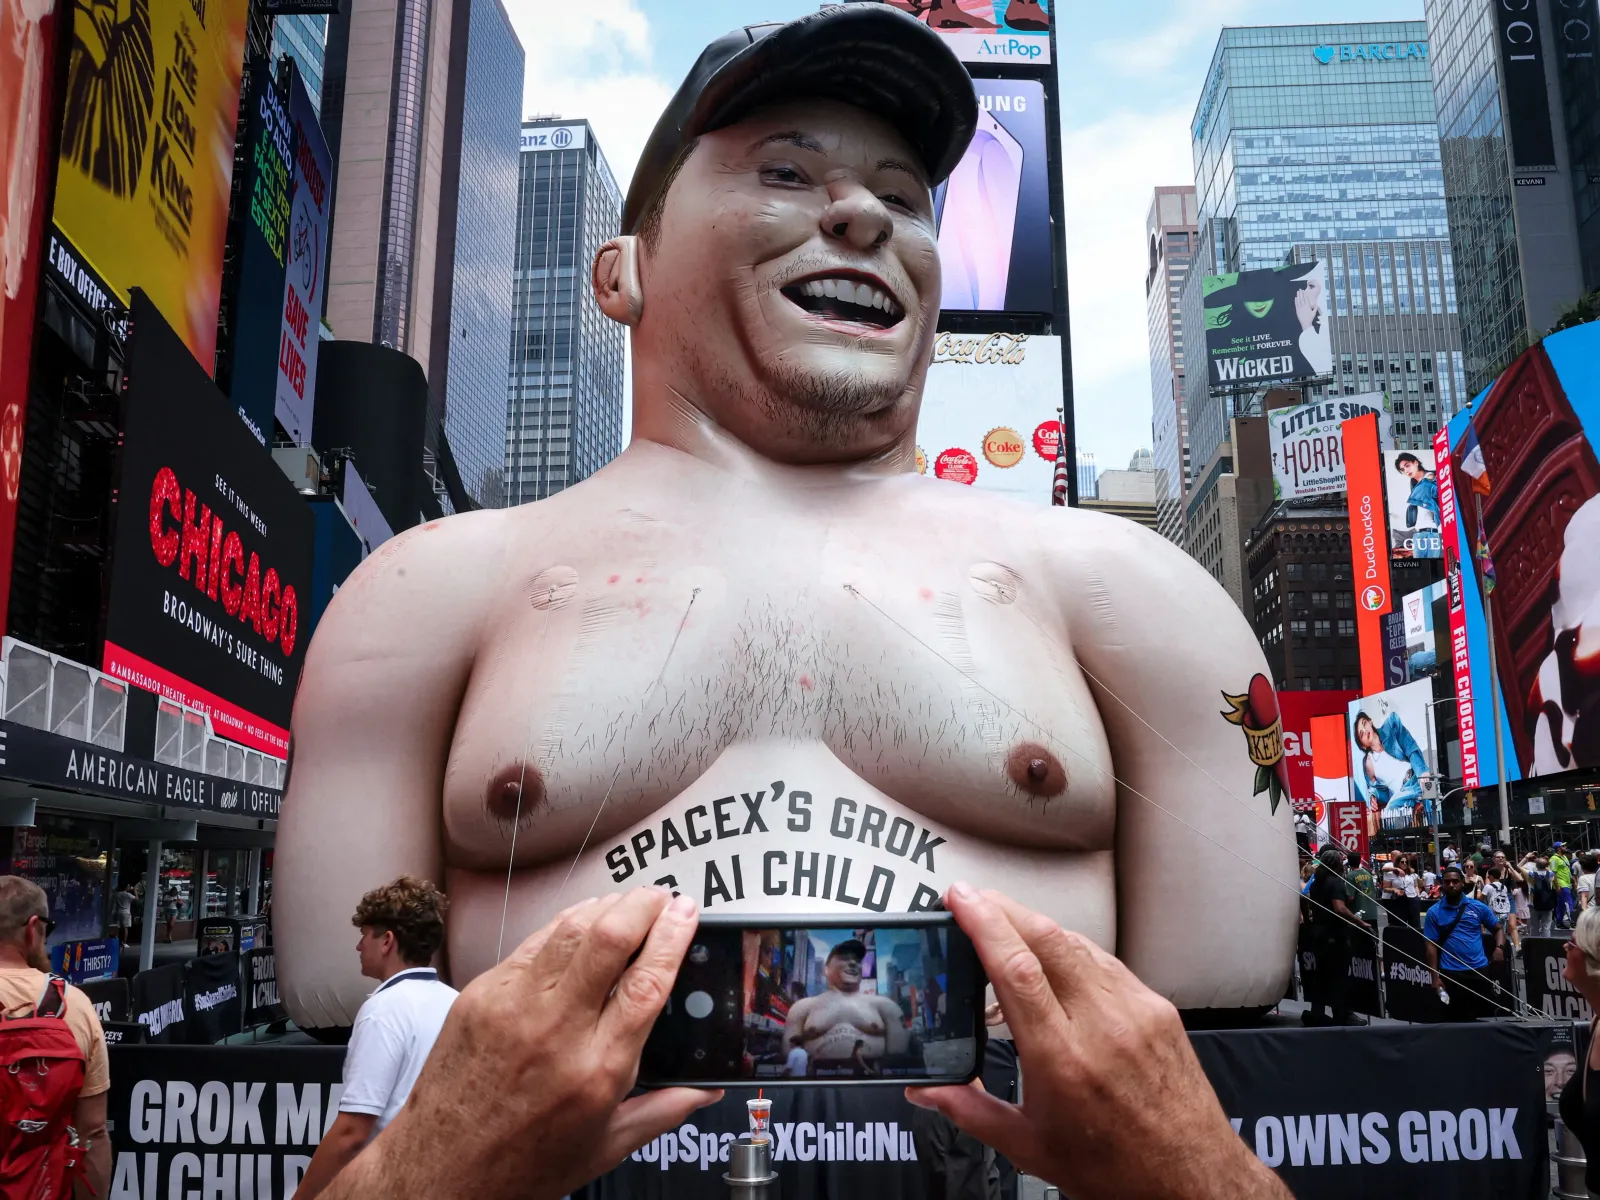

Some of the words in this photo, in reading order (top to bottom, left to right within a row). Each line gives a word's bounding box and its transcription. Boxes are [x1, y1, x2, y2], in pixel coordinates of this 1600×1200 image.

[174, 30, 197, 97] THE
[977, 39, 1041, 59] ArtPop
[1340, 42, 1429, 61] BARCLAY
[162, 66, 196, 152] LION
[260, 95, 272, 131] DO
[979, 95, 1026, 112] UNG
[520, 135, 547, 146] anz
[150, 121, 193, 226] KING
[57, 245, 77, 287] BOX
[78, 268, 107, 311] OFFICE
[285, 282, 309, 351] SAVE
[279, 329, 307, 400] LIVES
[1212, 345, 1248, 354] Remember
[1038, 429, 1064, 440] Cok
[1281, 403, 1335, 439] LITTLE
[1323, 425, 1333, 433] OF
[987, 441, 1020, 453] Coke
[1283, 436, 1345, 486] HORR
[1435, 430, 1449, 463] Y'S
[215, 474, 227, 496] SEE
[228, 488, 234, 503] IT
[236, 495, 249, 519] THIS
[250, 510, 267, 537] WEEK!
[1439, 464, 1455, 527] STORE
[1360, 495, 1376, 579] DuckDuckGo
[149, 466, 298, 657] CHICAGO
[163, 590, 233, 654] BROADWAY'S
[236, 640, 257, 670] SURE
[260, 655, 283, 686] THING
[1388, 612, 1405, 626] BROA
[1453, 625, 1468, 672] FREE
[116, 664, 160, 693] AMBASSADOR
[162, 684, 186, 705] THEATRE
[213, 709, 220, 720] AT
[220, 711, 244, 730] BROADWAY
[1282, 731, 1314, 757] GU
[1457, 675, 1478, 788] CHOCOLATE
[66, 749, 159, 796] AMERICAN
[166, 773, 205, 805] EAGLE
[605, 780, 813, 884] SPACEX'S
[830, 796, 947, 873] GROK
[1338, 804, 1362, 851] tkts
[703, 854, 745, 907] AI
[763, 850, 896, 912] CHILD
[83, 955, 111, 971] THIRSTY?
[1351, 956, 1374, 981] GROK
[1390, 961, 1433, 987] #StopSpa
[1545, 956, 1582, 993] GR
[93, 1001, 111, 1021] ES
[1565, 996, 1595, 1020] CH
[104, 1031, 123, 1041] CEX'S
[129, 1079, 267, 1145] GROK
[1255, 1111, 1391, 1168] OWNS
[1399, 1107, 1523, 1163] GROK
[110, 1152, 158, 1200] AI
